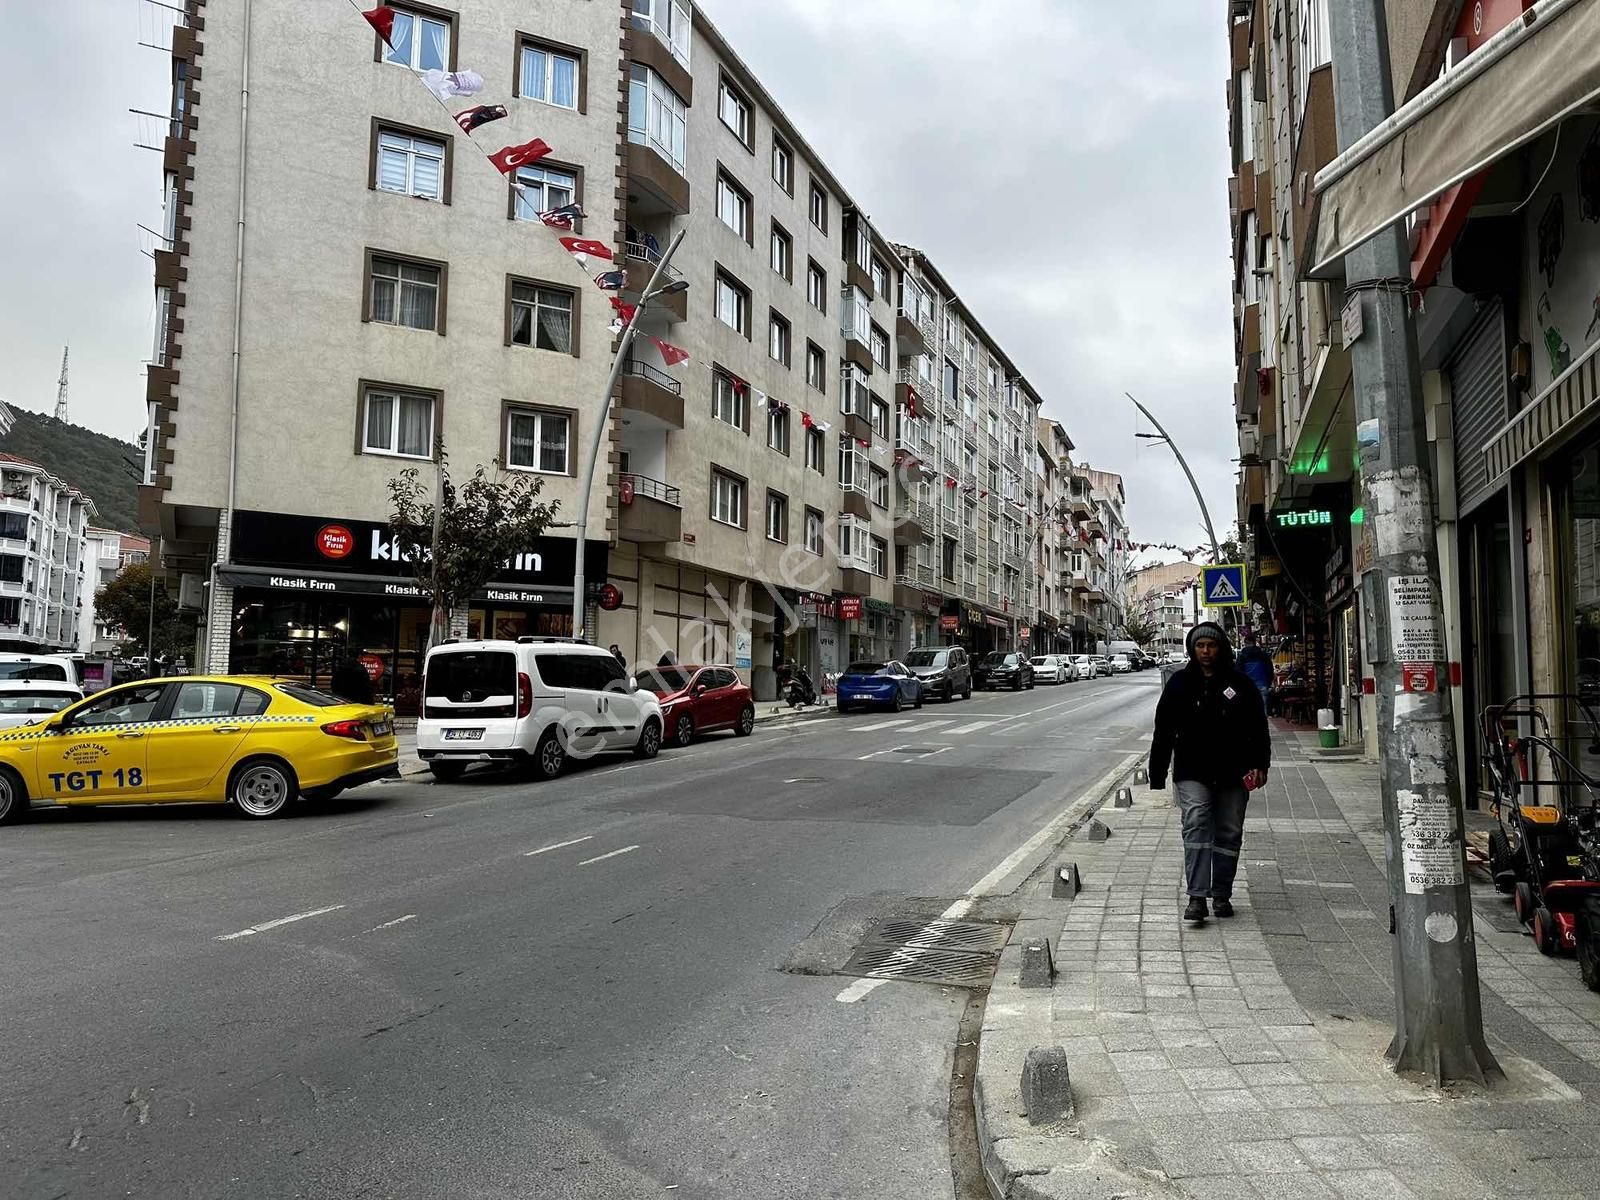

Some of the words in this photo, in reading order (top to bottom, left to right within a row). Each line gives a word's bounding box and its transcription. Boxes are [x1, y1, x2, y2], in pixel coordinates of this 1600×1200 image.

[1276, 510, 1331, 526] TÜTÜN
[270, 576, 307, 589] Klasik
[310, 579, 336, 590] Fırın
[385, 584, 419, 595] Klasik
[487, 590, 519, 601] Klasik
[521, 592, 543, 602] Fırın
[48, 770, 103, 792] TGT
[113, 767, 143, 787] 18
[1410, 876, 1429, 884] 0536
